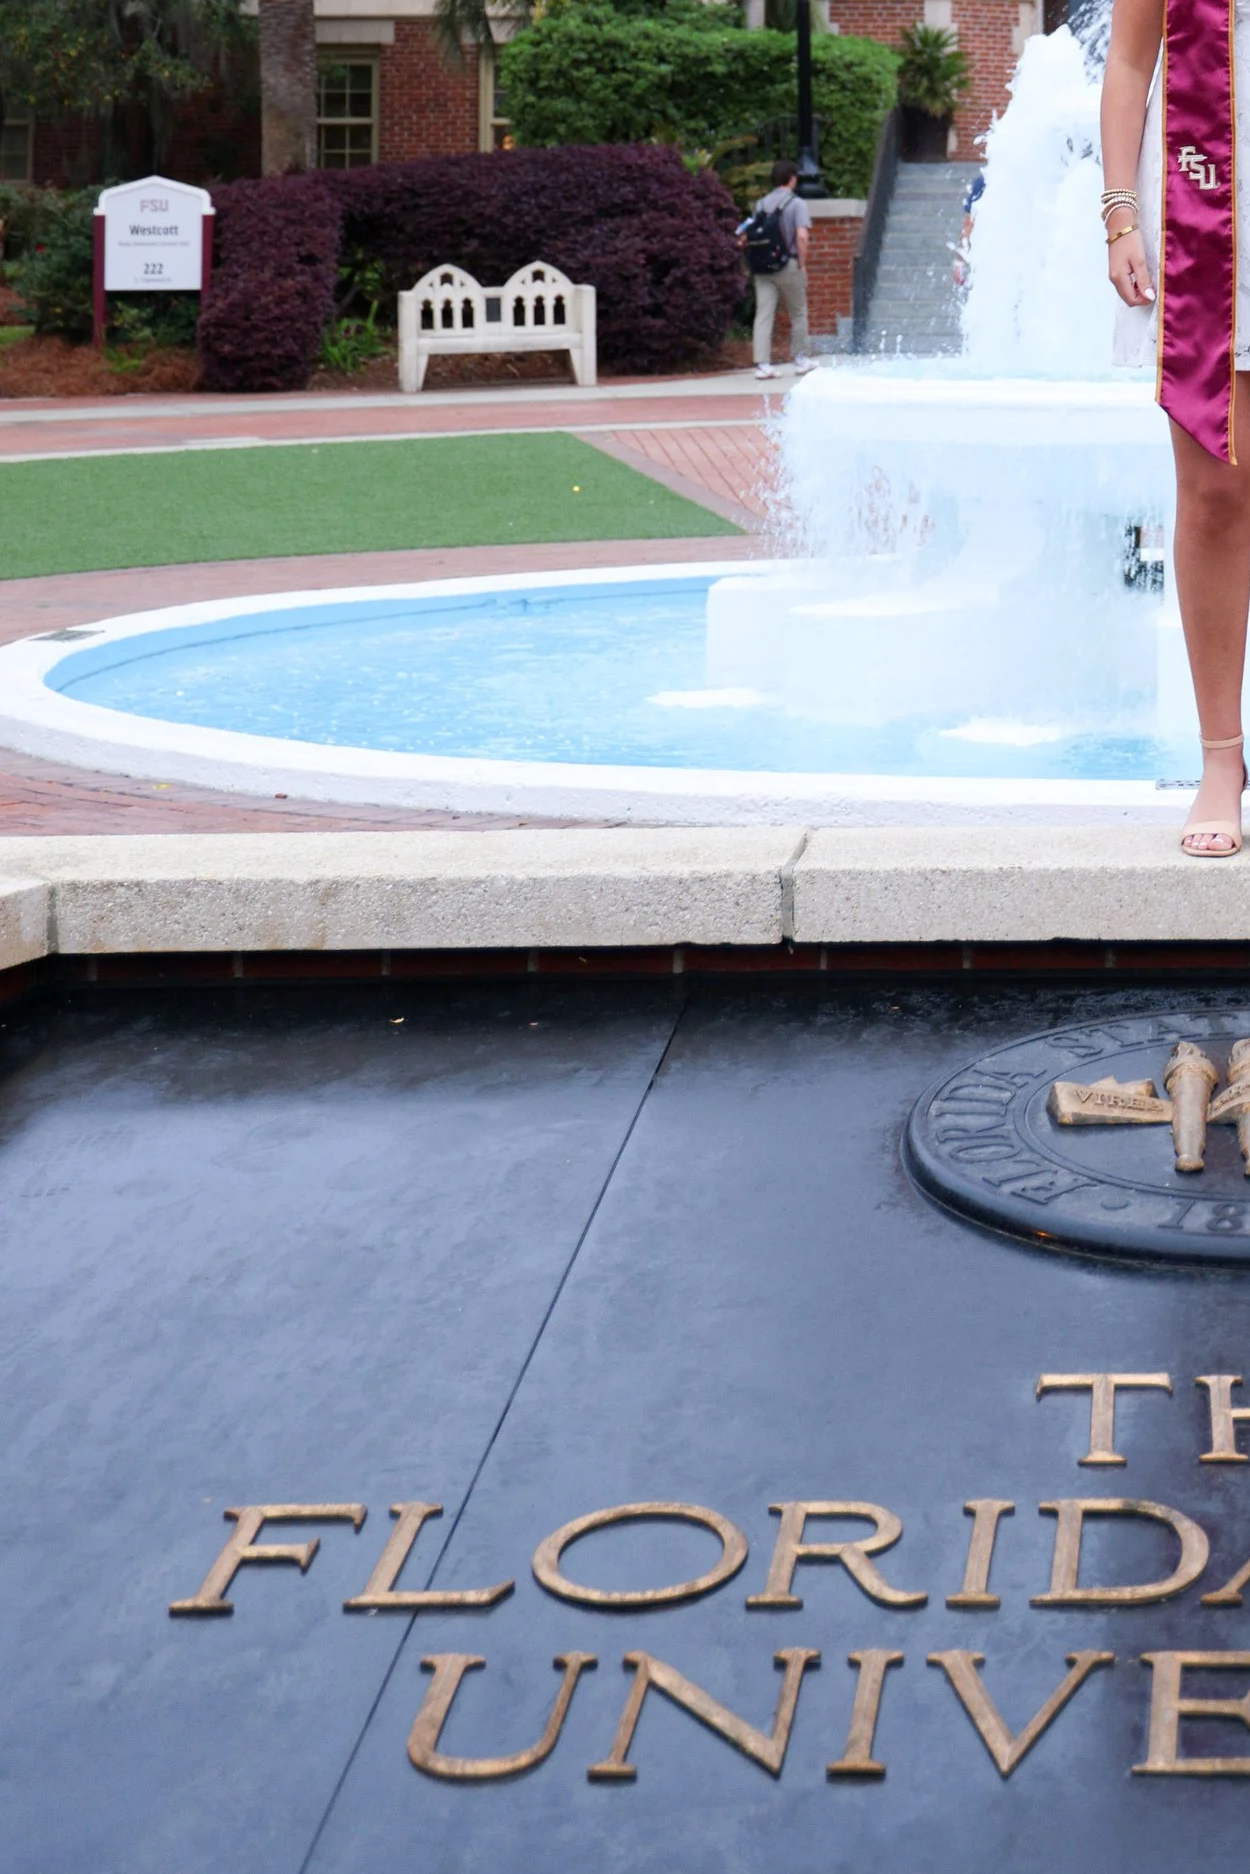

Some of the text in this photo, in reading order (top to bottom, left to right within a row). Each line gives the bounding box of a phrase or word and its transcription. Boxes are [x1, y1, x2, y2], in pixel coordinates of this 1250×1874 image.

[1177, 146, 1221, 190] FSU
[140, 199, 169, 213] FSU
[129, 225, 178, 236] Westcott
[143, 263, 164, 275] 222
[1073, 1088, 1165, 1113] VIRES
[935, 1069, 1098, 1205] FLORIDA
